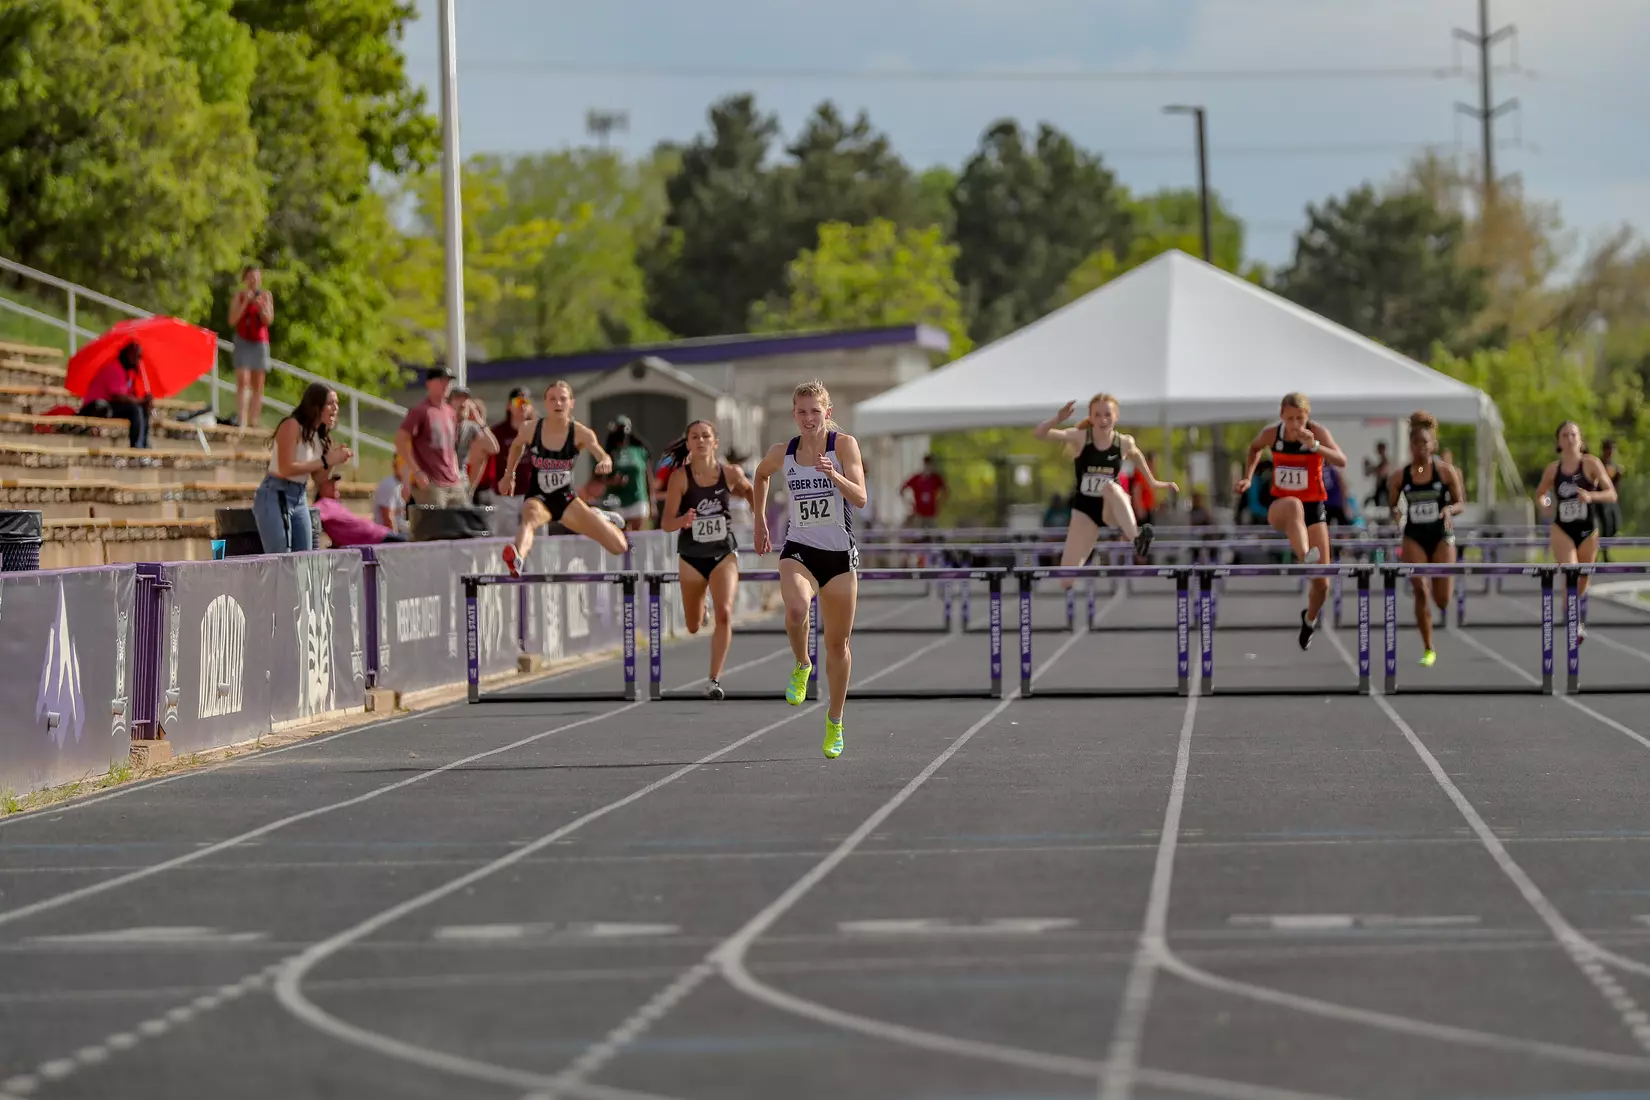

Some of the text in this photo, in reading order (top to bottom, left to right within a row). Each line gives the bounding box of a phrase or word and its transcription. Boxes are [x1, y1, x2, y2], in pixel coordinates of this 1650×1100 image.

[544, 472, 566, 487] 107
[813, 478, 836, 489] STAT
[1086, 475, 1109, 492] 17
[1280, 470, 1302, 484] 211
[698, 520, 721, 535] 264
[800, 499, 830, 520] 542
[468, 604, 477, 660] WEBER STATE
[625, 602, 634, 657] WEBER STATE
[651, 602, 659, 657] WEBER STATE
[992, 599, 1000, 654] WEBER STATE
[1021, 598, 1030, 654] WEBER STATE
[1178, 597, 1187, 653] WEBER STATE
[1202, 596, 1211, 653] WEBER STATE
[1359, 595, 1368, 652] WEBER STATE
[1386, 595, 1395, 651] WEBER STATE
[1543, 594, 1552, 651] WEBER STATE
[1568, 594, 1577, 650] WEBER STATE
